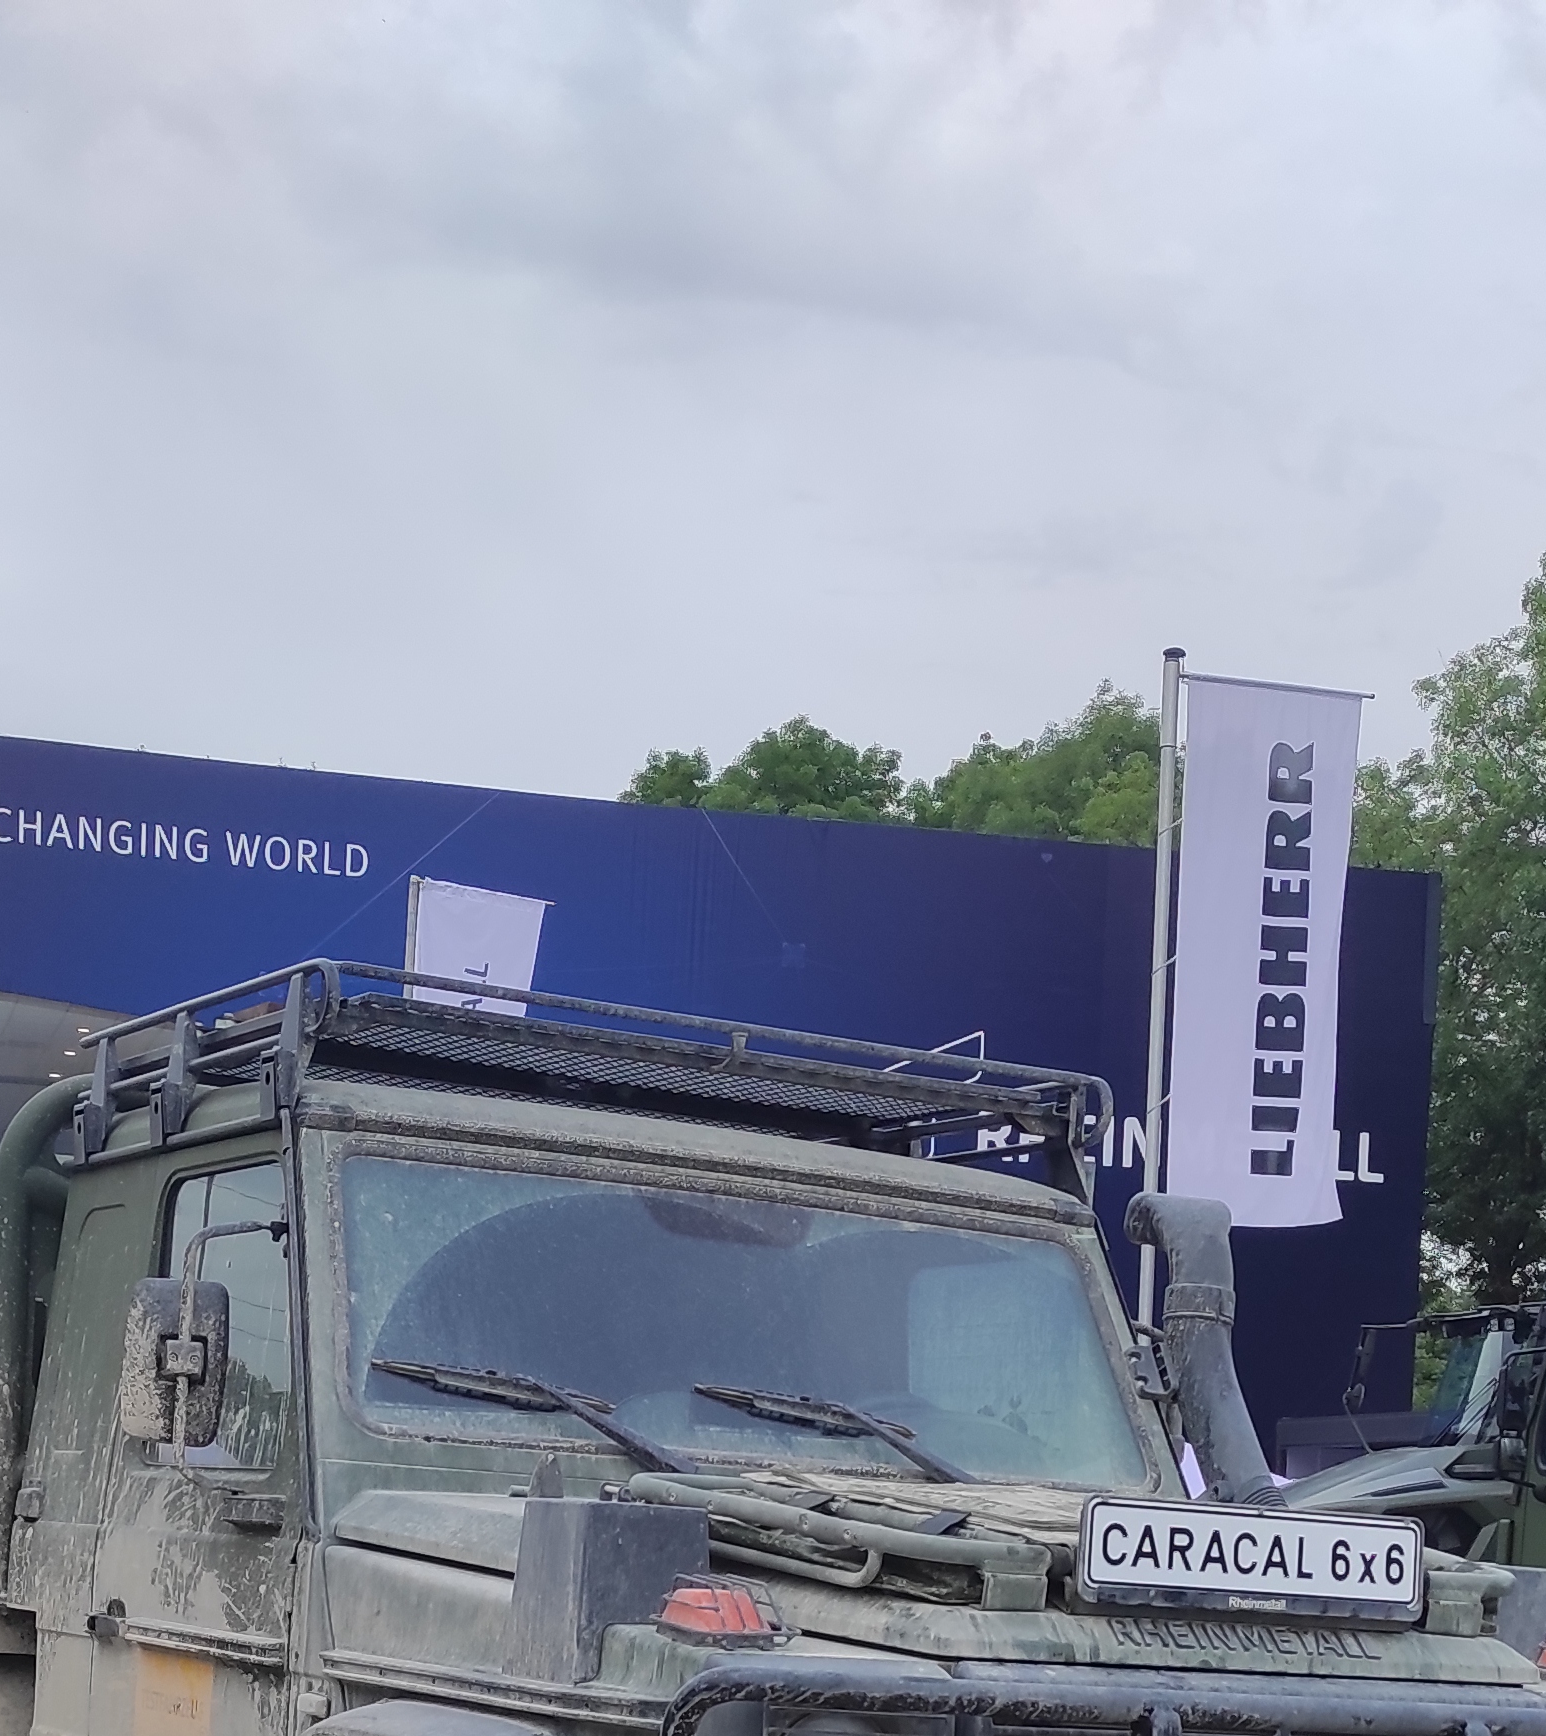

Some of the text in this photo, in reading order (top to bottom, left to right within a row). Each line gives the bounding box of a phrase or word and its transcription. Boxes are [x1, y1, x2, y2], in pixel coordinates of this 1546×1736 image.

[226, 831, 369, 877] WORLD
[1250, 742, 1314, 1176] LIEBHERR
[1102, 1523, 1405, 1585] CARACAL 6x6
[1228, 1596, 1287, 1611] Rheinmetall
[1106, 1618, 1382, 1661] RHEINMETALL
